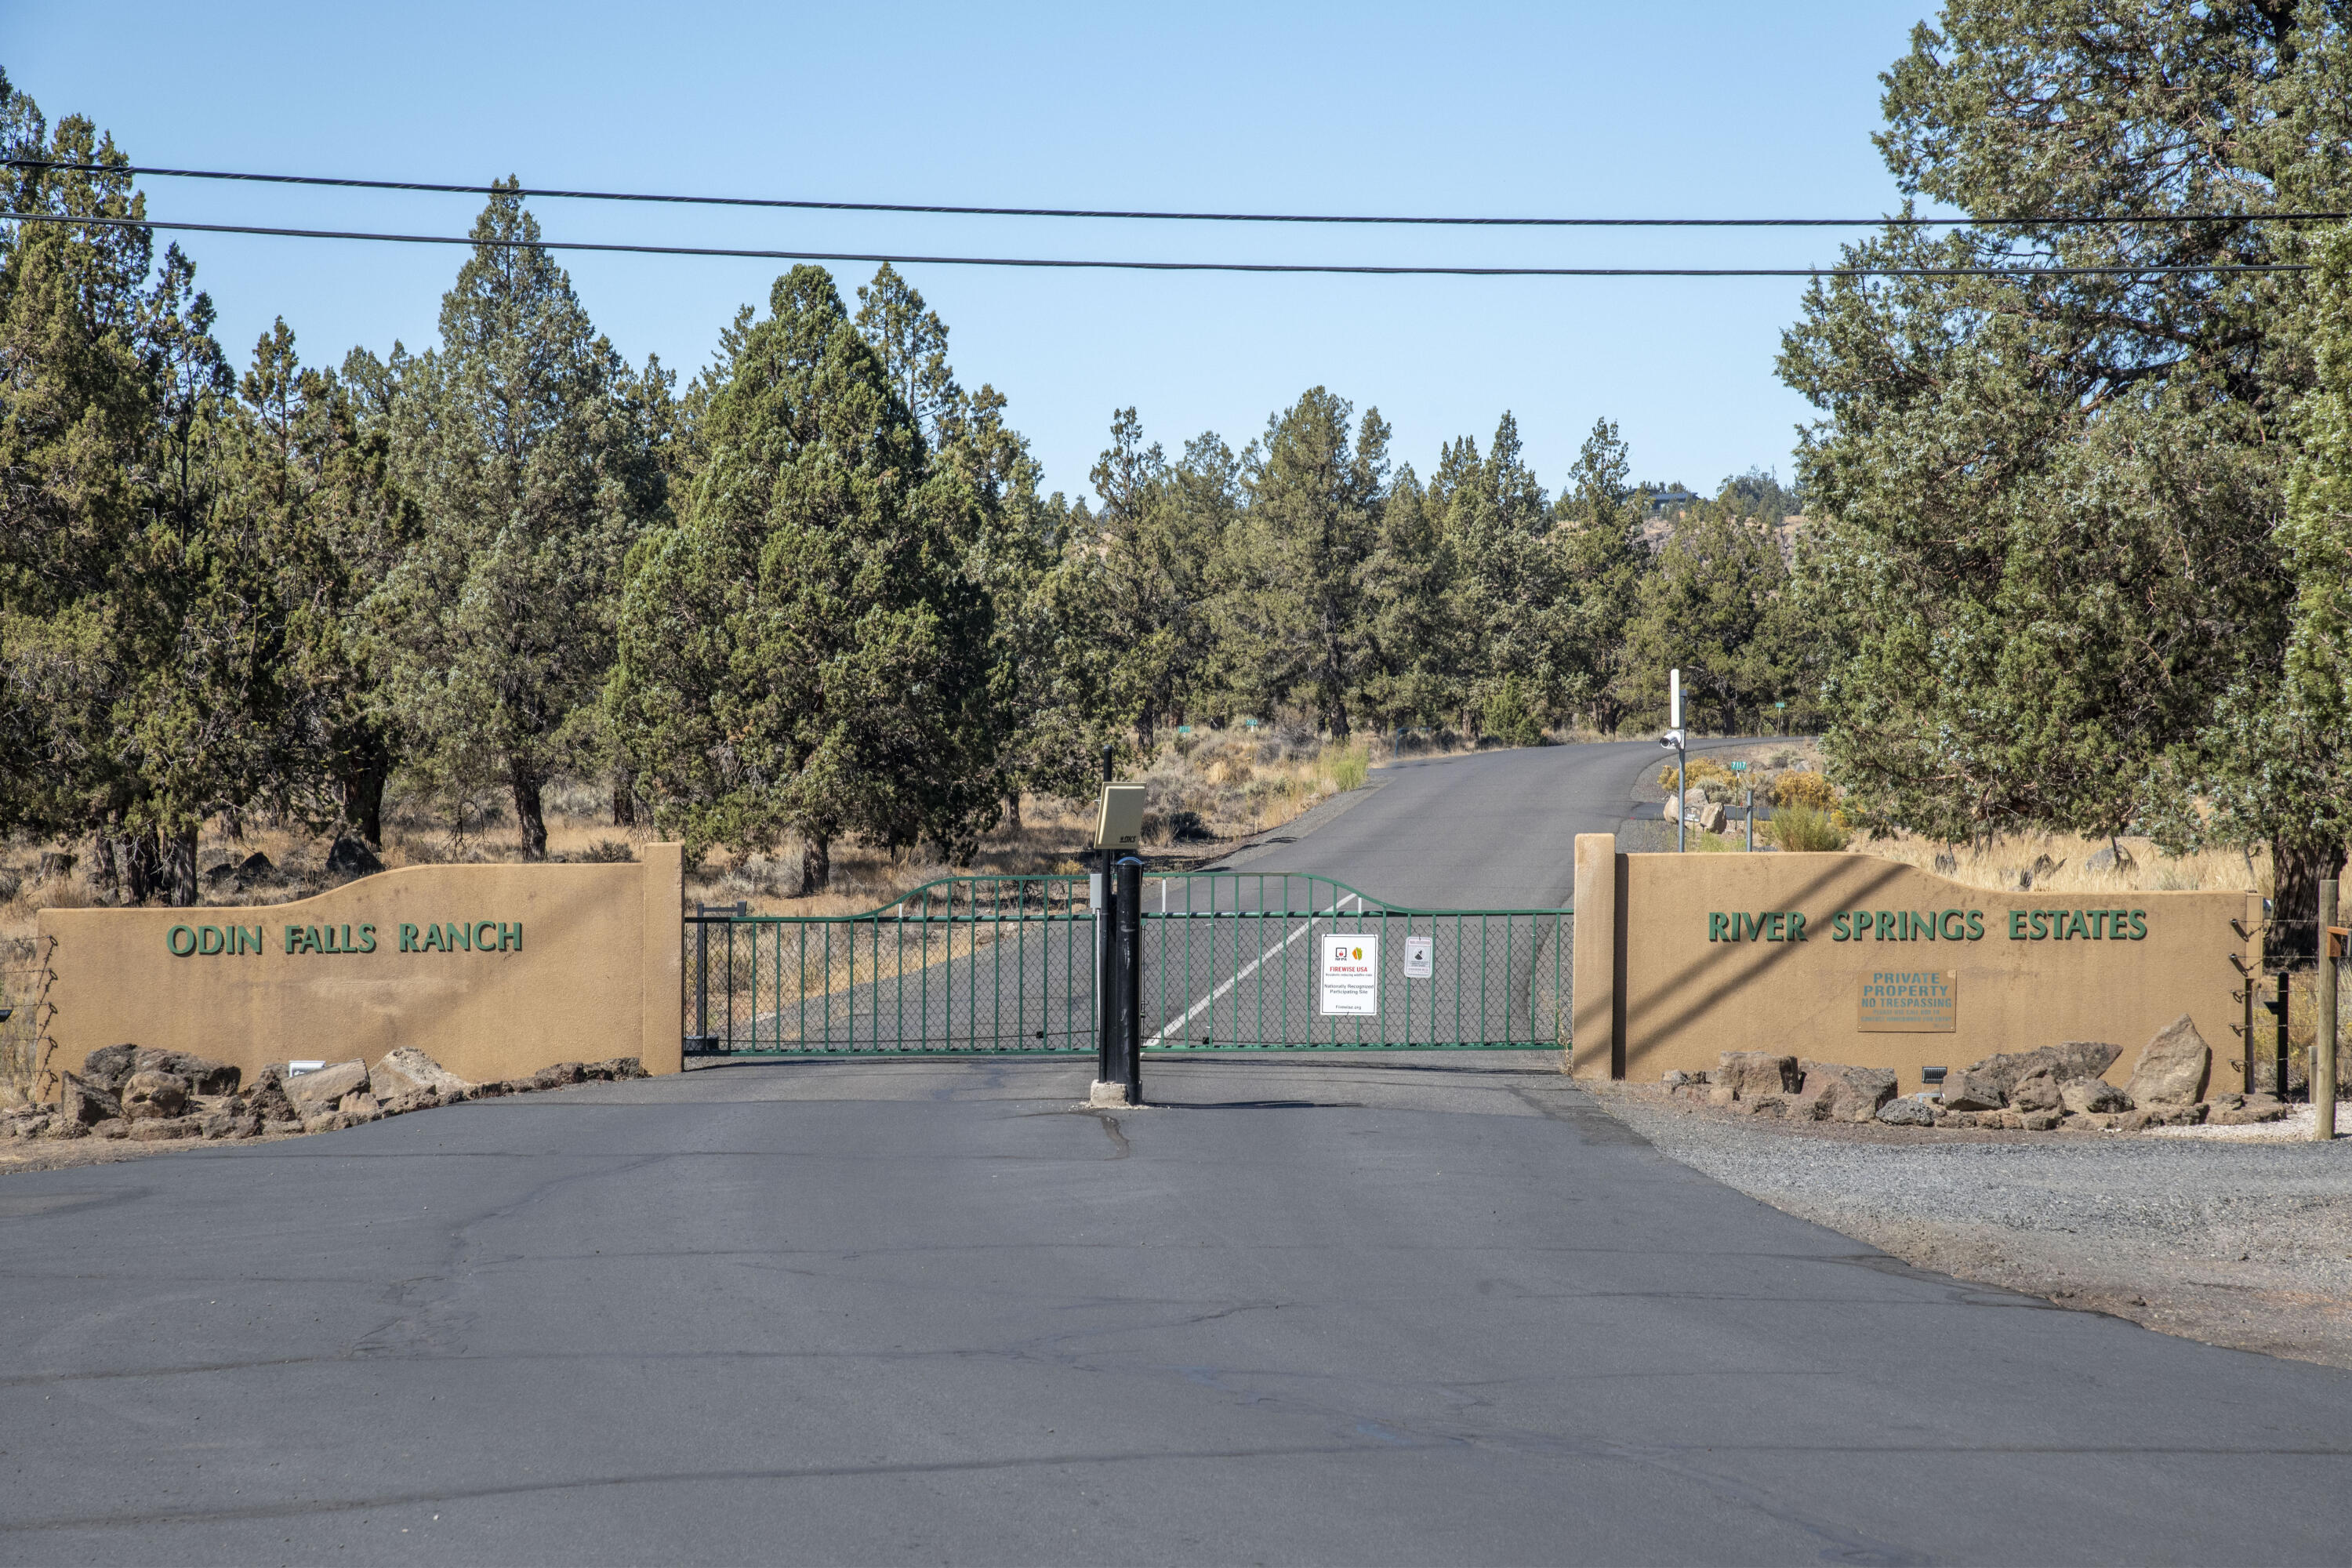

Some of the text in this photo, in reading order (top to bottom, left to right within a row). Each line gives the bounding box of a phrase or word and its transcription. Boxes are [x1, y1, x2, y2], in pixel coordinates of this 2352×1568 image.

[1708, 909, 2147, 941] RIVER SPRINGS ESTATES
[166, 920, 521, 955] ODIN FALLS RANCH
[1873, 972, 1940, 984] PRIVATE
[1864, 985, 1948, 996] PROPERTY
[1861, 997, 1951, 1008] NO TRESPASSING
